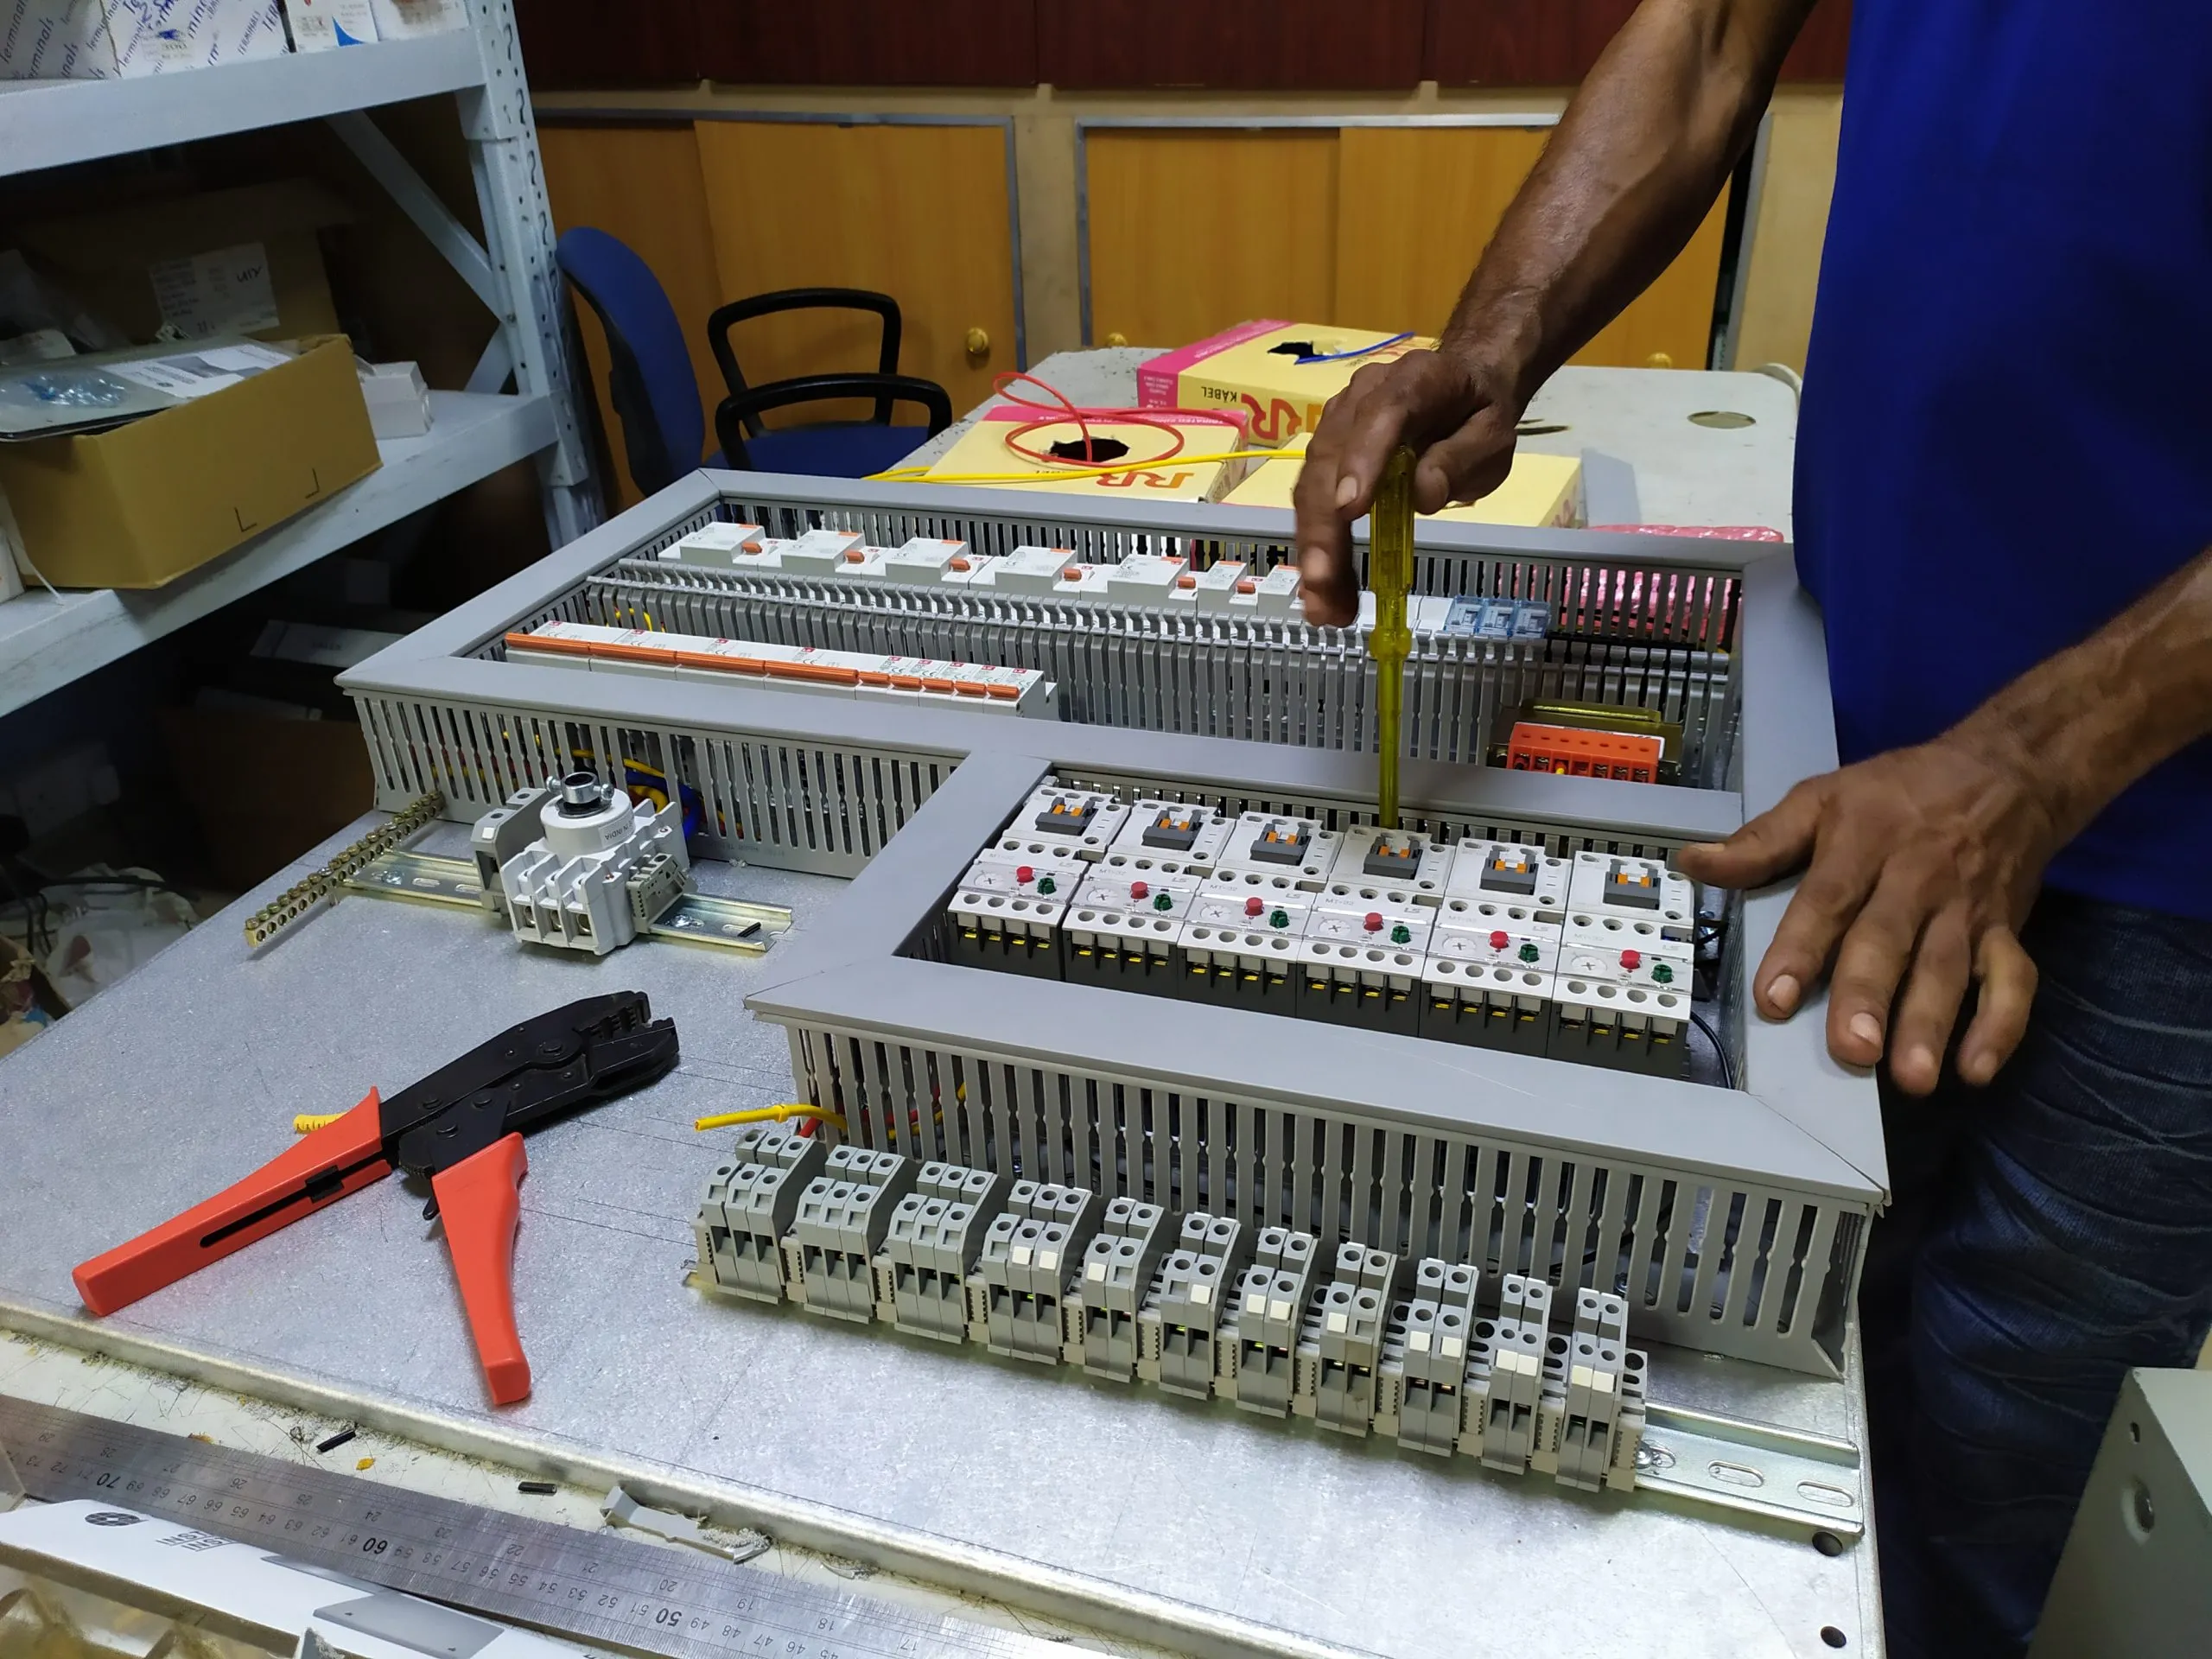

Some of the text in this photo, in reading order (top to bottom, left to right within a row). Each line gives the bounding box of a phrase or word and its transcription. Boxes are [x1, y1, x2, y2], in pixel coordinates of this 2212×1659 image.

[27, 1455, 43, 1466] 73
[50, 1462, 68, 1473] 72
[96, 1473, 121, 1489] 70
[126, 1480, 144, 1493] 69
[230, 1478, 247, 1490] 26
[152, 1486, 170, 1498] 68
[177, 1495, 197, 1505] 67
[203, 1499, 223, 1511] 66
[296, 1493, 313, 1505] 25
[231, 1506, 250, 1518] 65
[258, 1512, 276, 1525] 64
[365, 1511, 382, 1522] 24
[284, 1519, 302, 1531] 63
[311, 1525, 330, 1538] 62
[340, 1534, 359, 1545] 61
[435, 1527, 453, 1539] 23
[362, 1537, 388, 1554] 60
[506, 1544, 524, 1556] 22
[394, 1546, 413, 1559] 59
[423, 1552, 442, 1566] 58
[450, 1560, 471, 1573] 57
[479, 1566, 499, 1580] 56
[582, 1562, 599, 1573] 21
[508, 1573, 529, 1586] 55
[659, 1579, 678, 1592] 20
[538, 1580, 558, 1594] 54
[568, 1586, 588, 1600] 53
[597, 1593, 619, 1608] 52
[736, 1598, 754, 1611] 19
[630, 1603, 650, 1616] 51
[655, 1607, 683, 1627] 50
[690, 1617, 710, 1630] 49
[721, 1624, 741, 1638] 48
[817, 1618, 836, 1631] 18
[753, 1633, 774, 1646] 47
[900, 1639, 918, 1651] 17
[785, 1641, 806, 1655] 46
